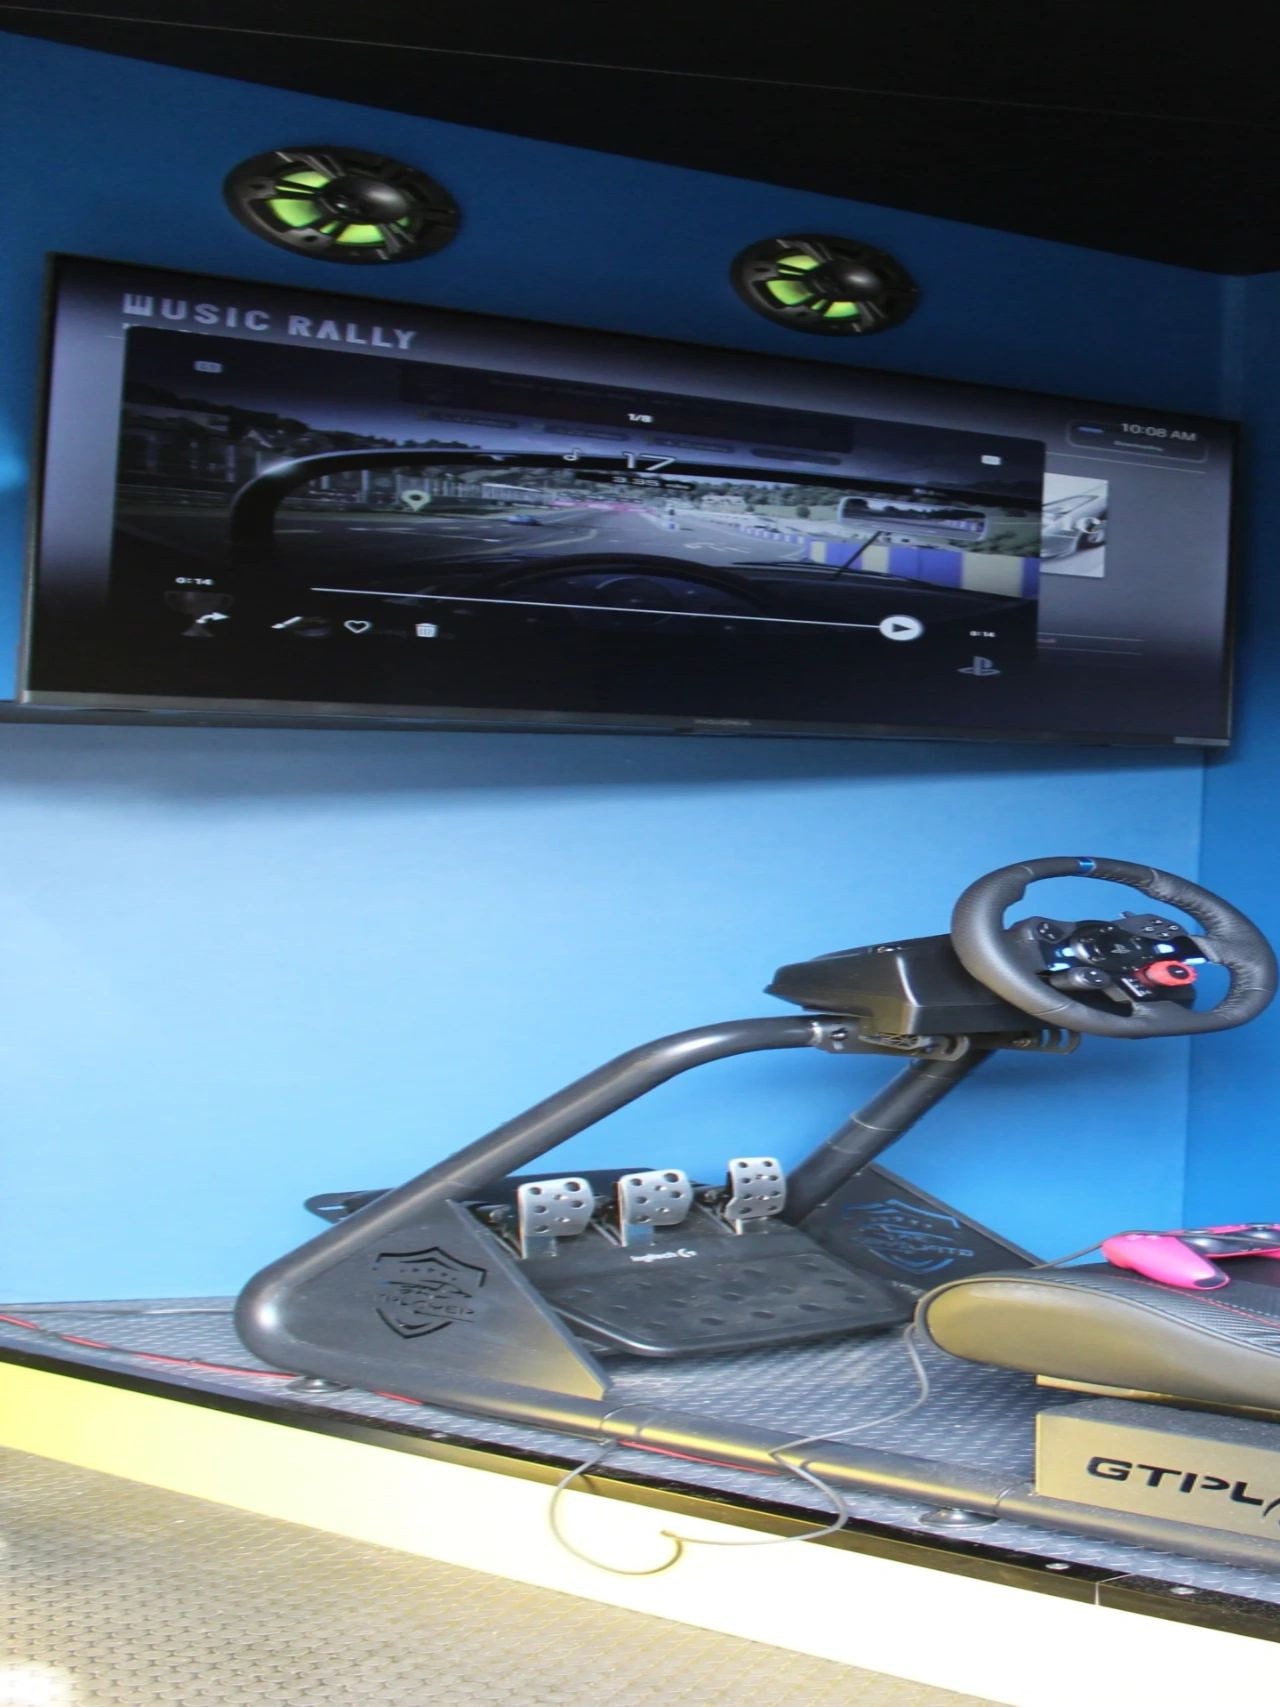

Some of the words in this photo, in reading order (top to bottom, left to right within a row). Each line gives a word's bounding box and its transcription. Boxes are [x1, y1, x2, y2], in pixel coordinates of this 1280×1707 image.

[288, 315, 417, 350] RALLY
[1121, 423, 1167, 438] 10:08
[1170, 430, 1197, 442] AM
[622, 451, 677, 471] 17
